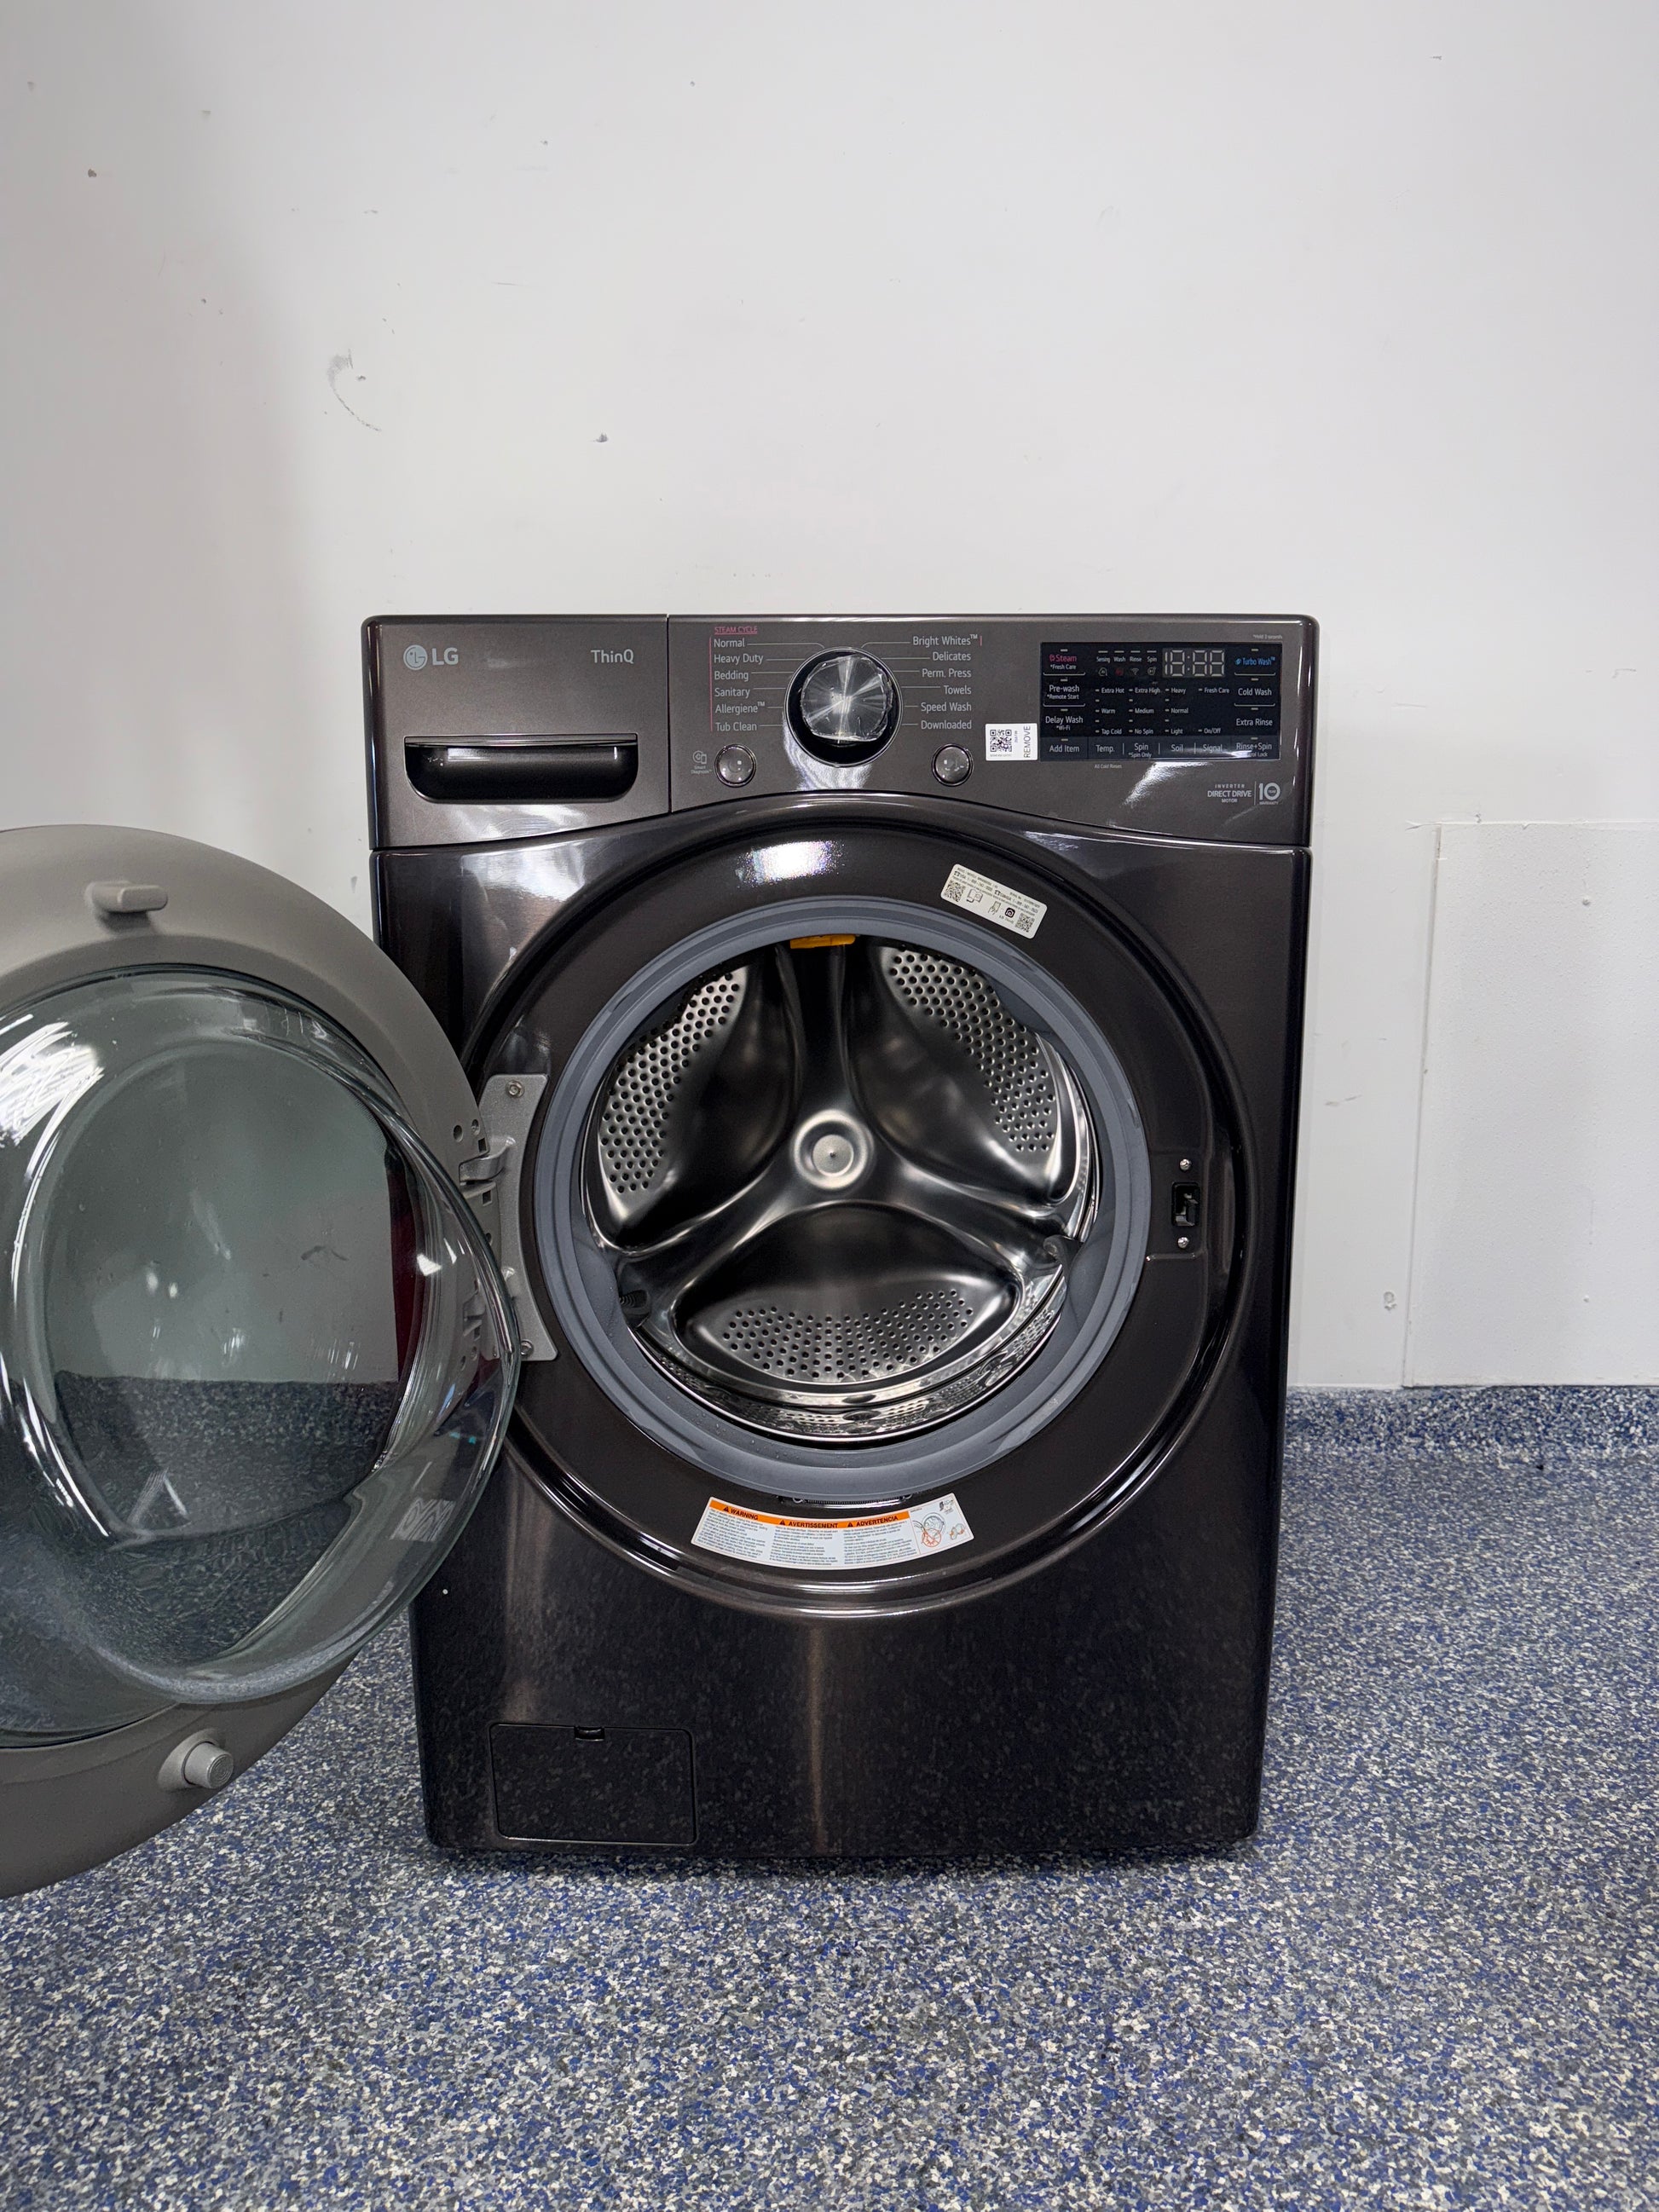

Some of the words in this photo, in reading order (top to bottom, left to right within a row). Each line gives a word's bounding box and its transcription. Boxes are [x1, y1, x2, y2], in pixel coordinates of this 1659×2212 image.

[714, 638, 745, 648] Normal
[913, 636, 939, 648] Bright
[432, 648, 459, 665] LG
[591, 649, 634, 663] ThinQ
[714, 654, 740, 665] Heavy
[743, 653, 764, 665] Duty
[933, 651, 971, 661] Delicates
[714, 671, 749, 682] Bedding
[922, 668, 946, 678] Perm.
[948, 668, 971, 678] Press
[714, 687, 750, 698] Sanitary
[944, 685, 972, 694] Towels
[715, 701, 765, 715] Allergiene™
[921, 702, 946, 713] Speed
[950, 702, 972, 711] Wash
[922, 720, 972, 729] Downloaded
[1045, 716, 1064, 725] Delay
[715, 722, 731, 731] Tub
[733, 722, 757, 731] Clean
[1096, 745, 1115, 754] Temp.
[1134, 743, 1149, 752] Spin
[1203, 744, 1223, 754] Signal
[1236, 742, 1272, 751] Rinse+Spin
[730, 1508, 759, 1521] WARNING
[856, 1516, 899, 1527] ADVERTENCIA
